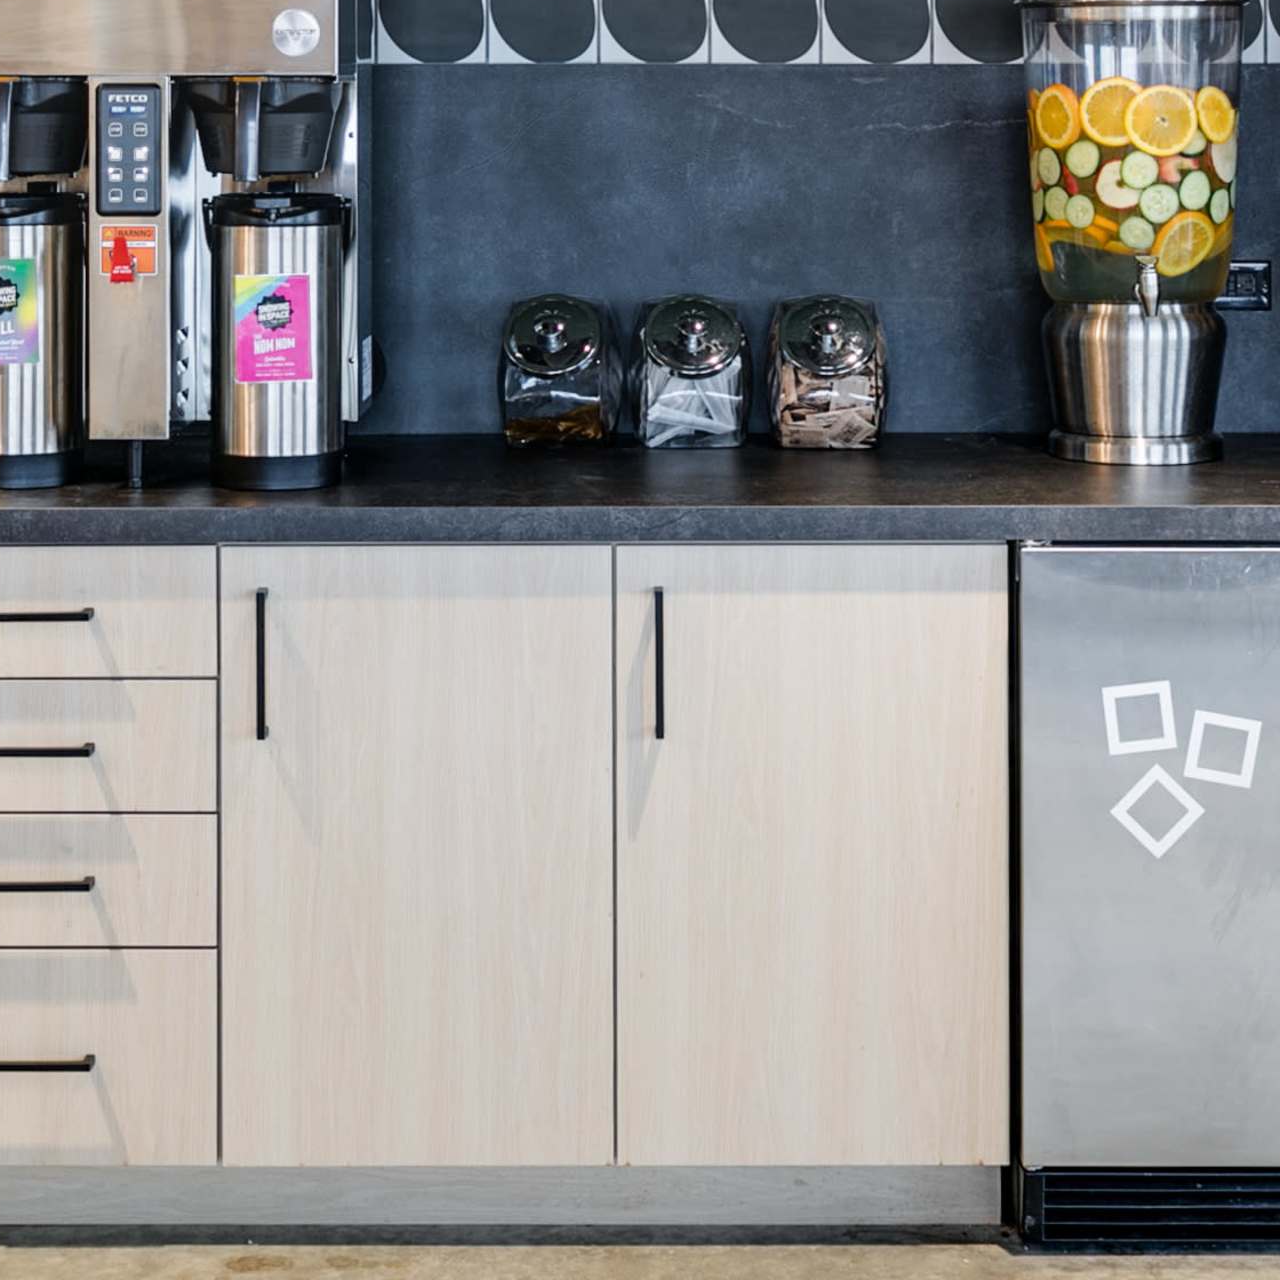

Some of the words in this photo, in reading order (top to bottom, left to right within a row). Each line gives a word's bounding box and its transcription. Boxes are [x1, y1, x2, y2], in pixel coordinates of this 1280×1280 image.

[107, 94, 148, 103] FETCO
[117, 229, 152, 237] WARNING
[254, 338, 274, 355] NOM
[275, 337, 296, 351] NOM
